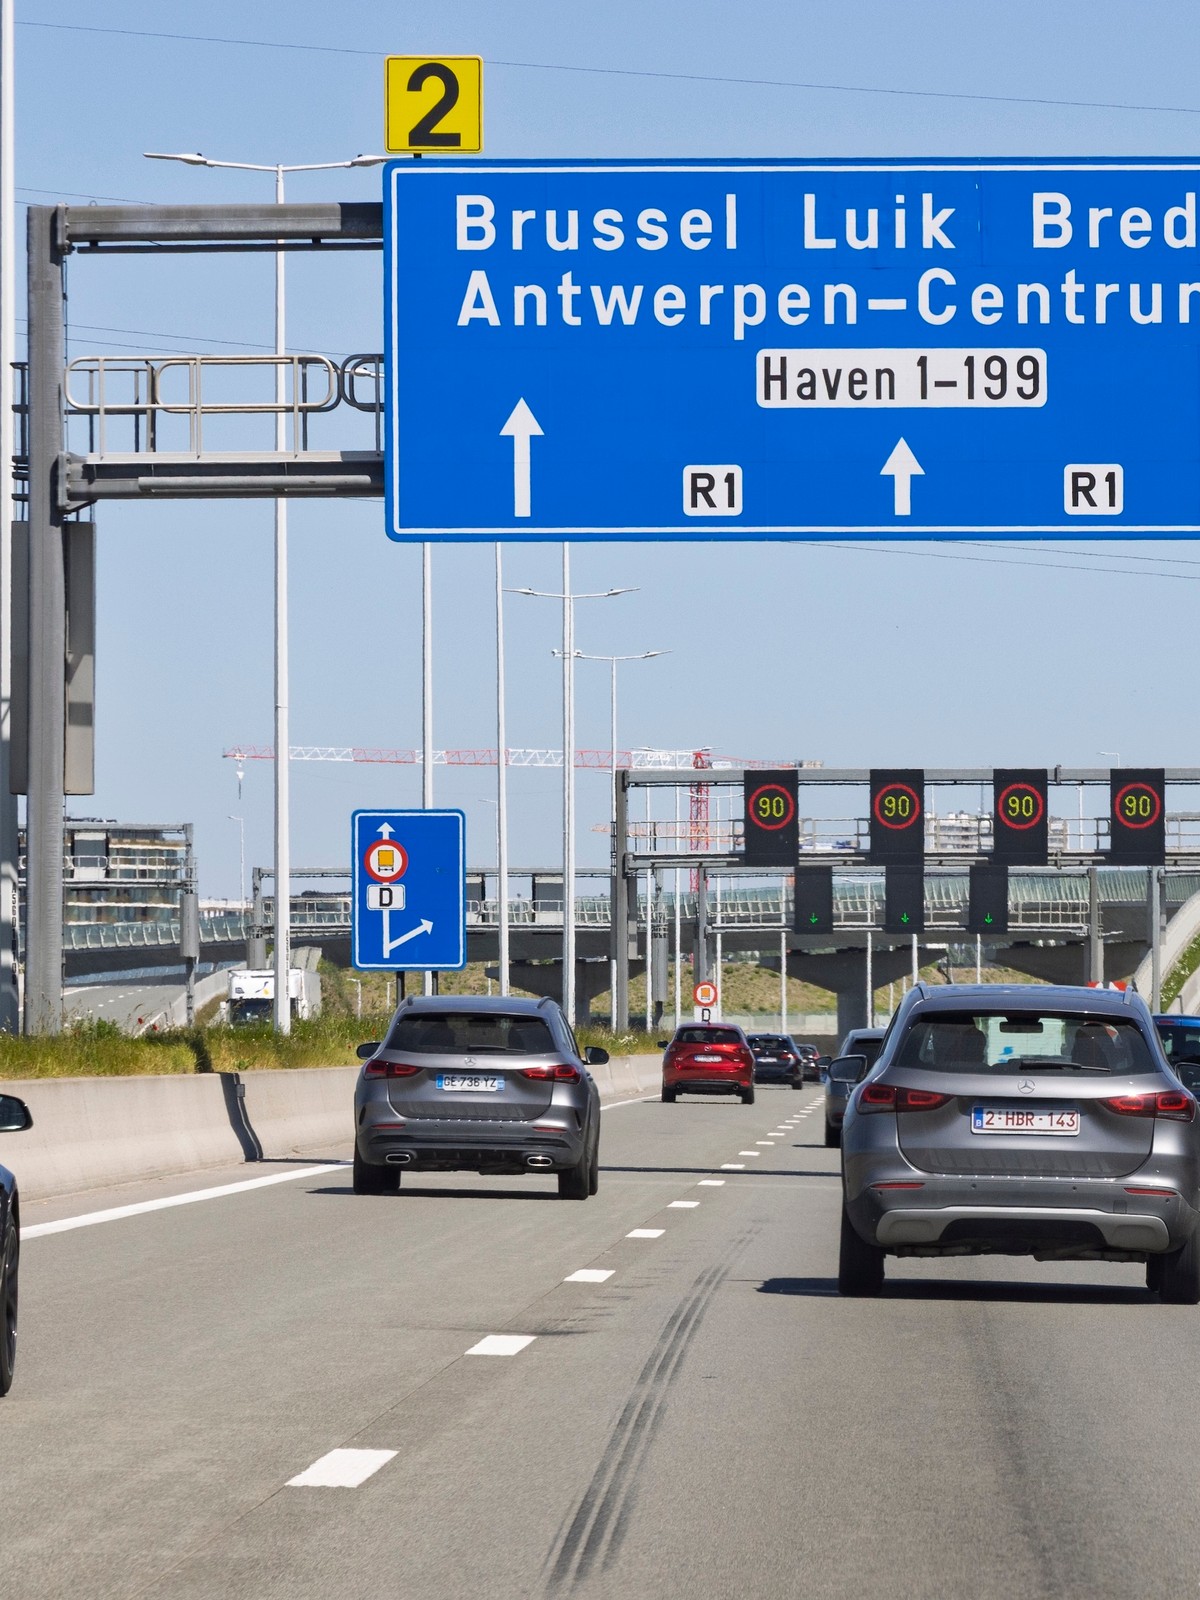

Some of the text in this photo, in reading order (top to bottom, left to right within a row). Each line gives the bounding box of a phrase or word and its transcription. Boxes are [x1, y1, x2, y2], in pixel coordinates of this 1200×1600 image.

[407, 63, 461, 146] 2
[456, 193, 737, 251] Brussel
[804, 192, 956, 250] Luik
[763, 355, 1040, 401] Haven 1-199
[690, 472, 736, 509] R1
[1071, 471, 1117, 508] R1
[758, 796, 785, 818] 90
[884, 795, 910, 817] 90
[1008, 795, 1033, 817] 90
[1124, 795, 1151, 817] 90
[379, 887, 393, 907] D
[701, 1008, 711, 1022] D
[985, 1110, 1076, 1127] 2-HBR-143
